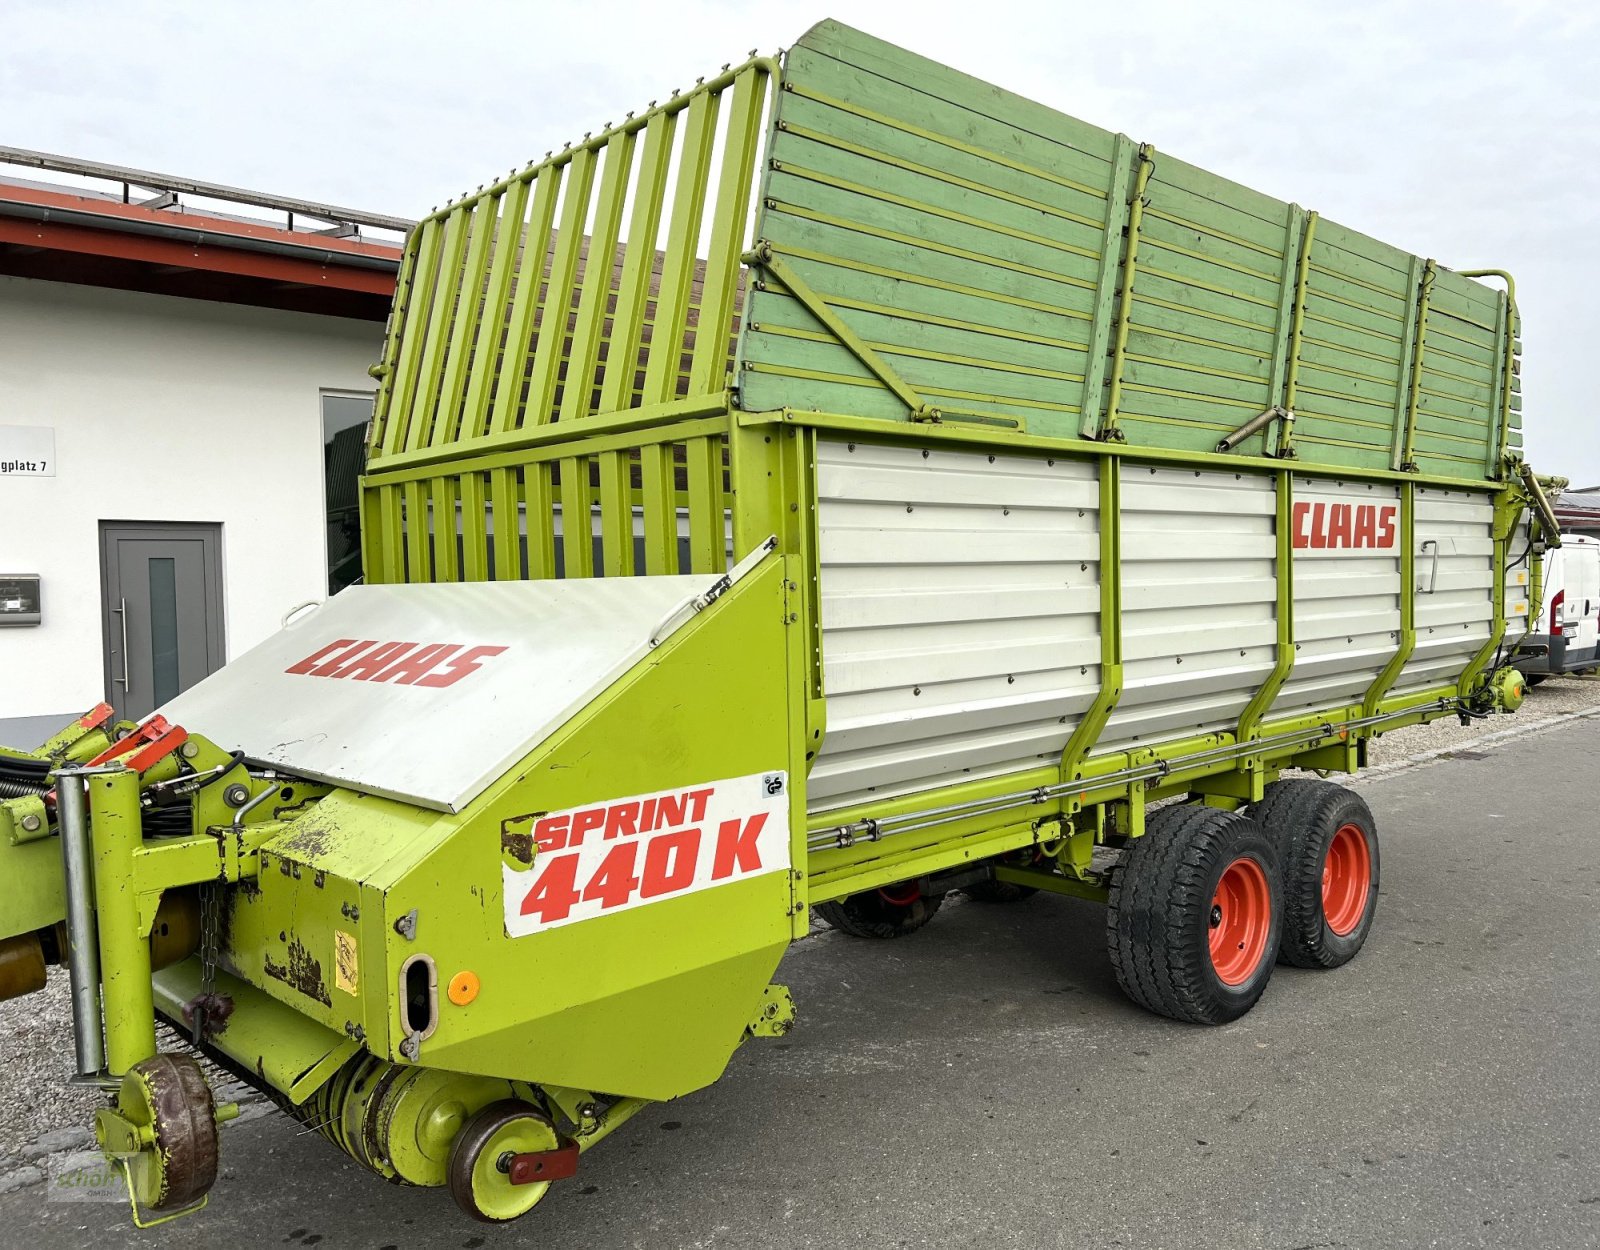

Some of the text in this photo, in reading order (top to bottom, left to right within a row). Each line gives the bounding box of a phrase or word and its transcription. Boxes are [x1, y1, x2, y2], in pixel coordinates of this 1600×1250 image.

[1, 460, 46, 472] gplatz 7
[1292, 502, 1396, 549] CLAAS
[284, 639, 510, 688] CLAAS
[533, 788, 714, 853] SPRINT
[519, 812, 769, 924] 440 K
